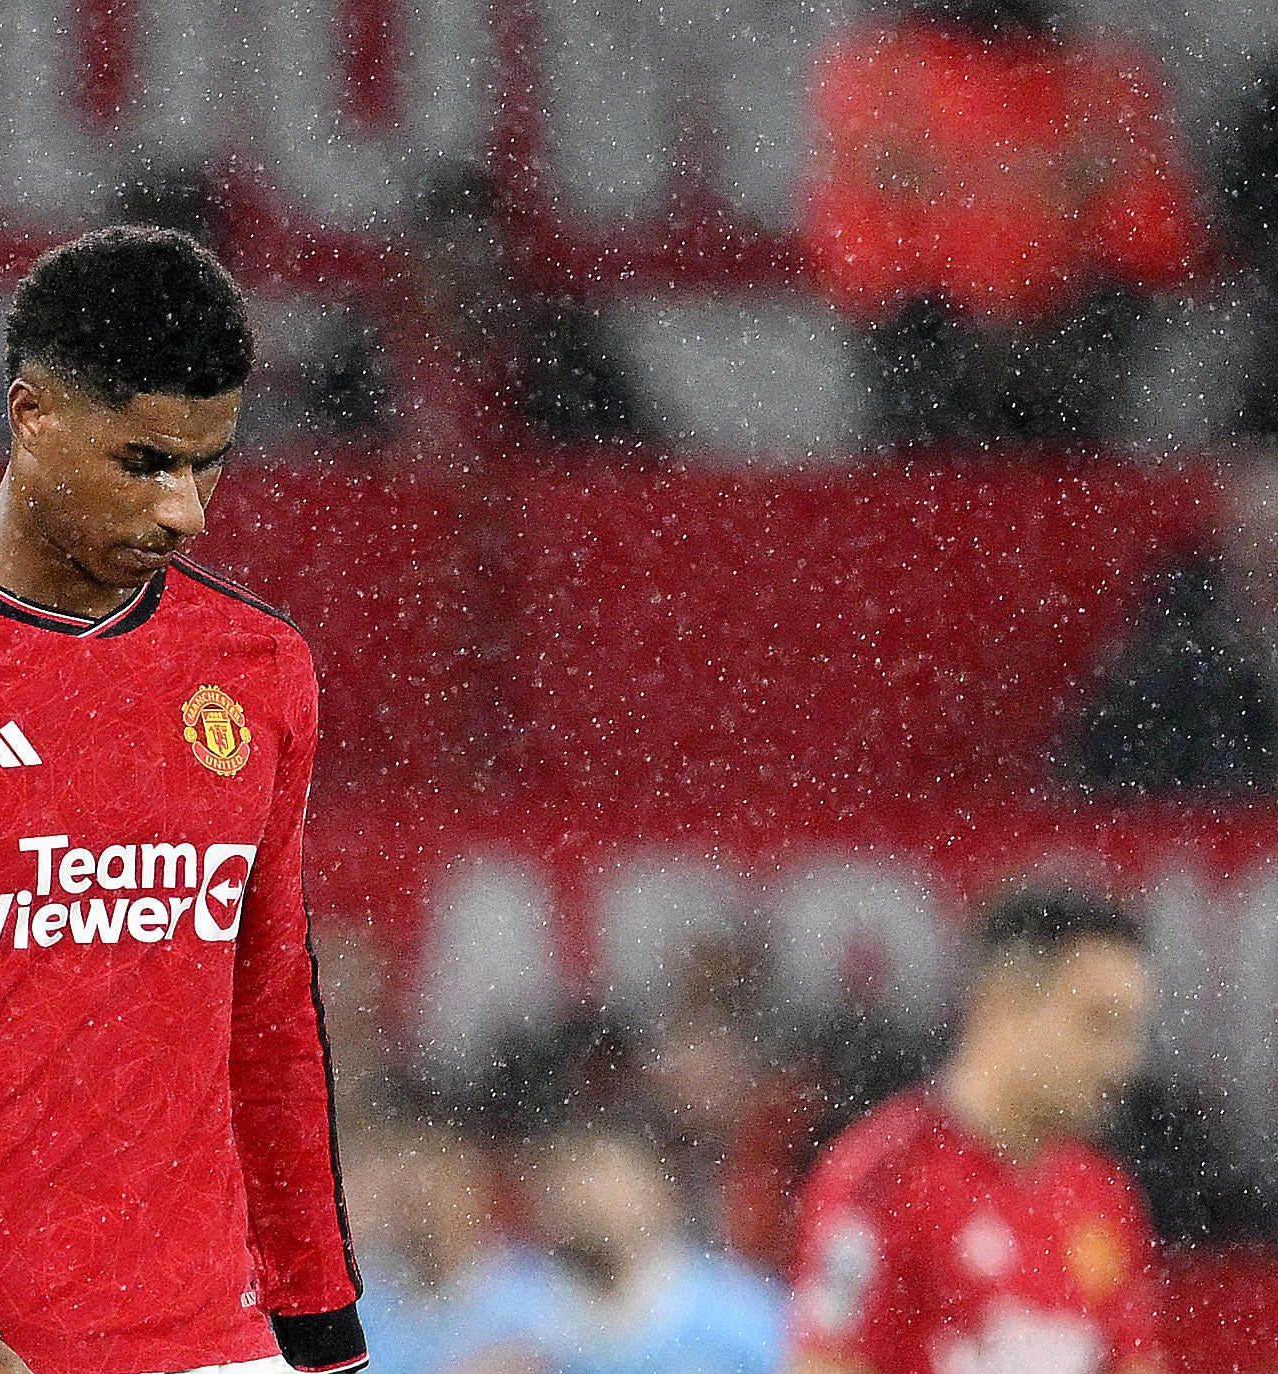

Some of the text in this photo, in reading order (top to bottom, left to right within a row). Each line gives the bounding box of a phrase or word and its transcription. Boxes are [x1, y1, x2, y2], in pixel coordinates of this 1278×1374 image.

[187, 692, 242, 722] MANCHESTER
[205, 754, 244, 770] UNITED
[18, 834, 198, 896] Team
